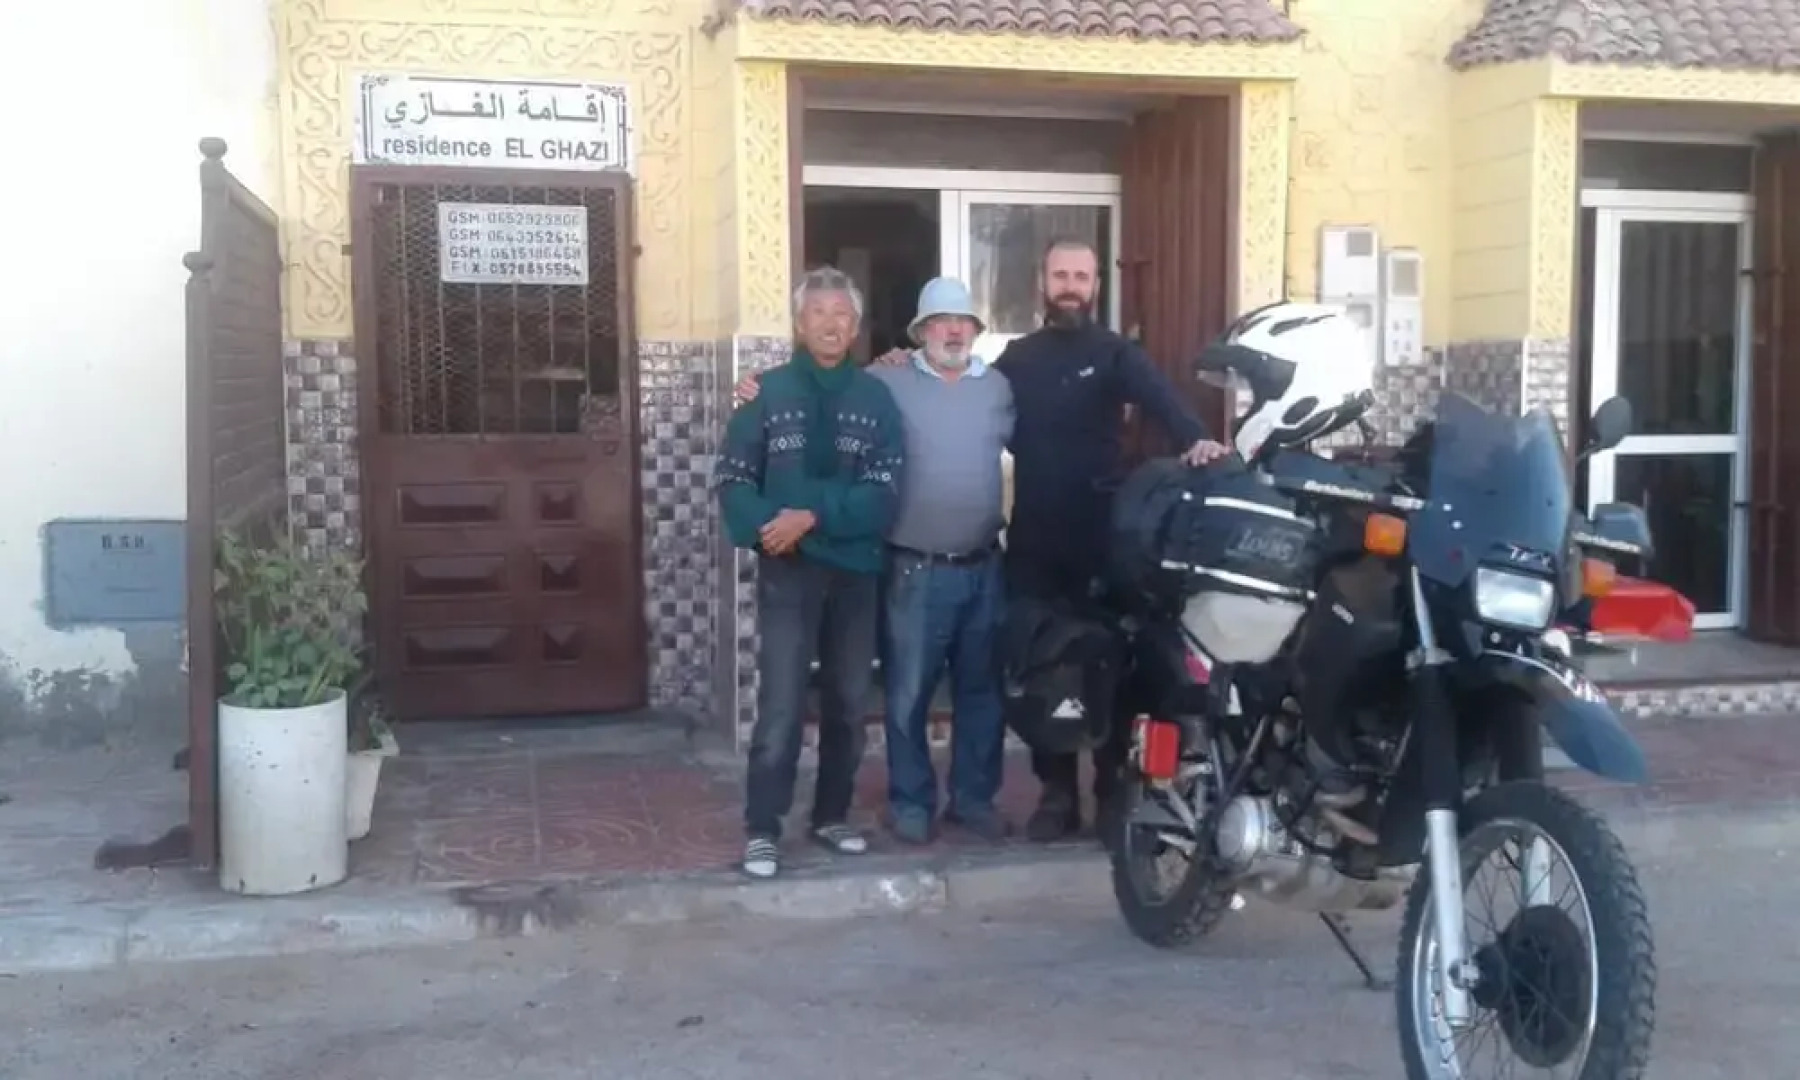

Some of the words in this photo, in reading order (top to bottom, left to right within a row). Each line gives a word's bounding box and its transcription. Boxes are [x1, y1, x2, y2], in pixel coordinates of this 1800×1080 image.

[383, 134, 492, 157] residence
[505, 138, 533, 158] EL
[540, 139, 608, 160] GHAZI
